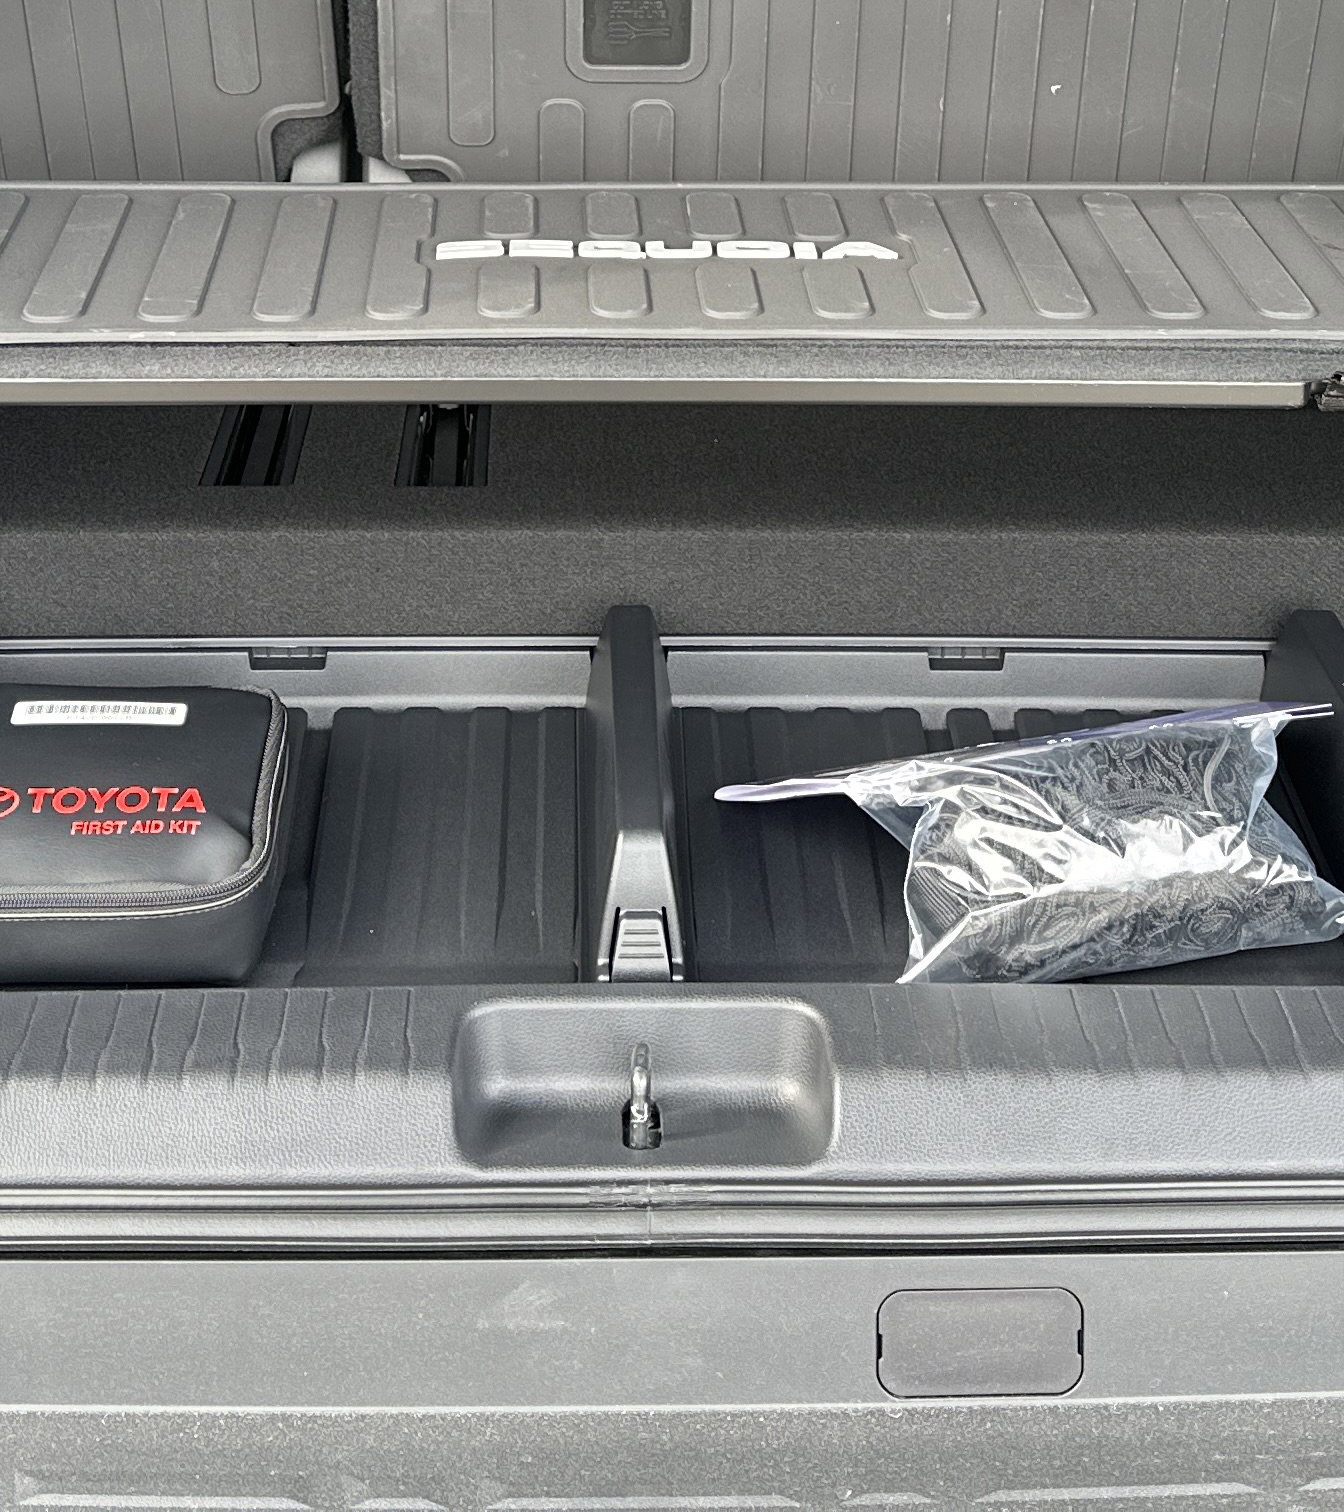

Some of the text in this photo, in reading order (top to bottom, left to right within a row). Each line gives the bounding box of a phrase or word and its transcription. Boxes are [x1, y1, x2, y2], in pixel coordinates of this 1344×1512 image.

[435, 239, 900, 261] SEQUOIA
[27, 786, 207, 814] TOYOTA
[70, 819, 202, 836] FIRST AID KIT
